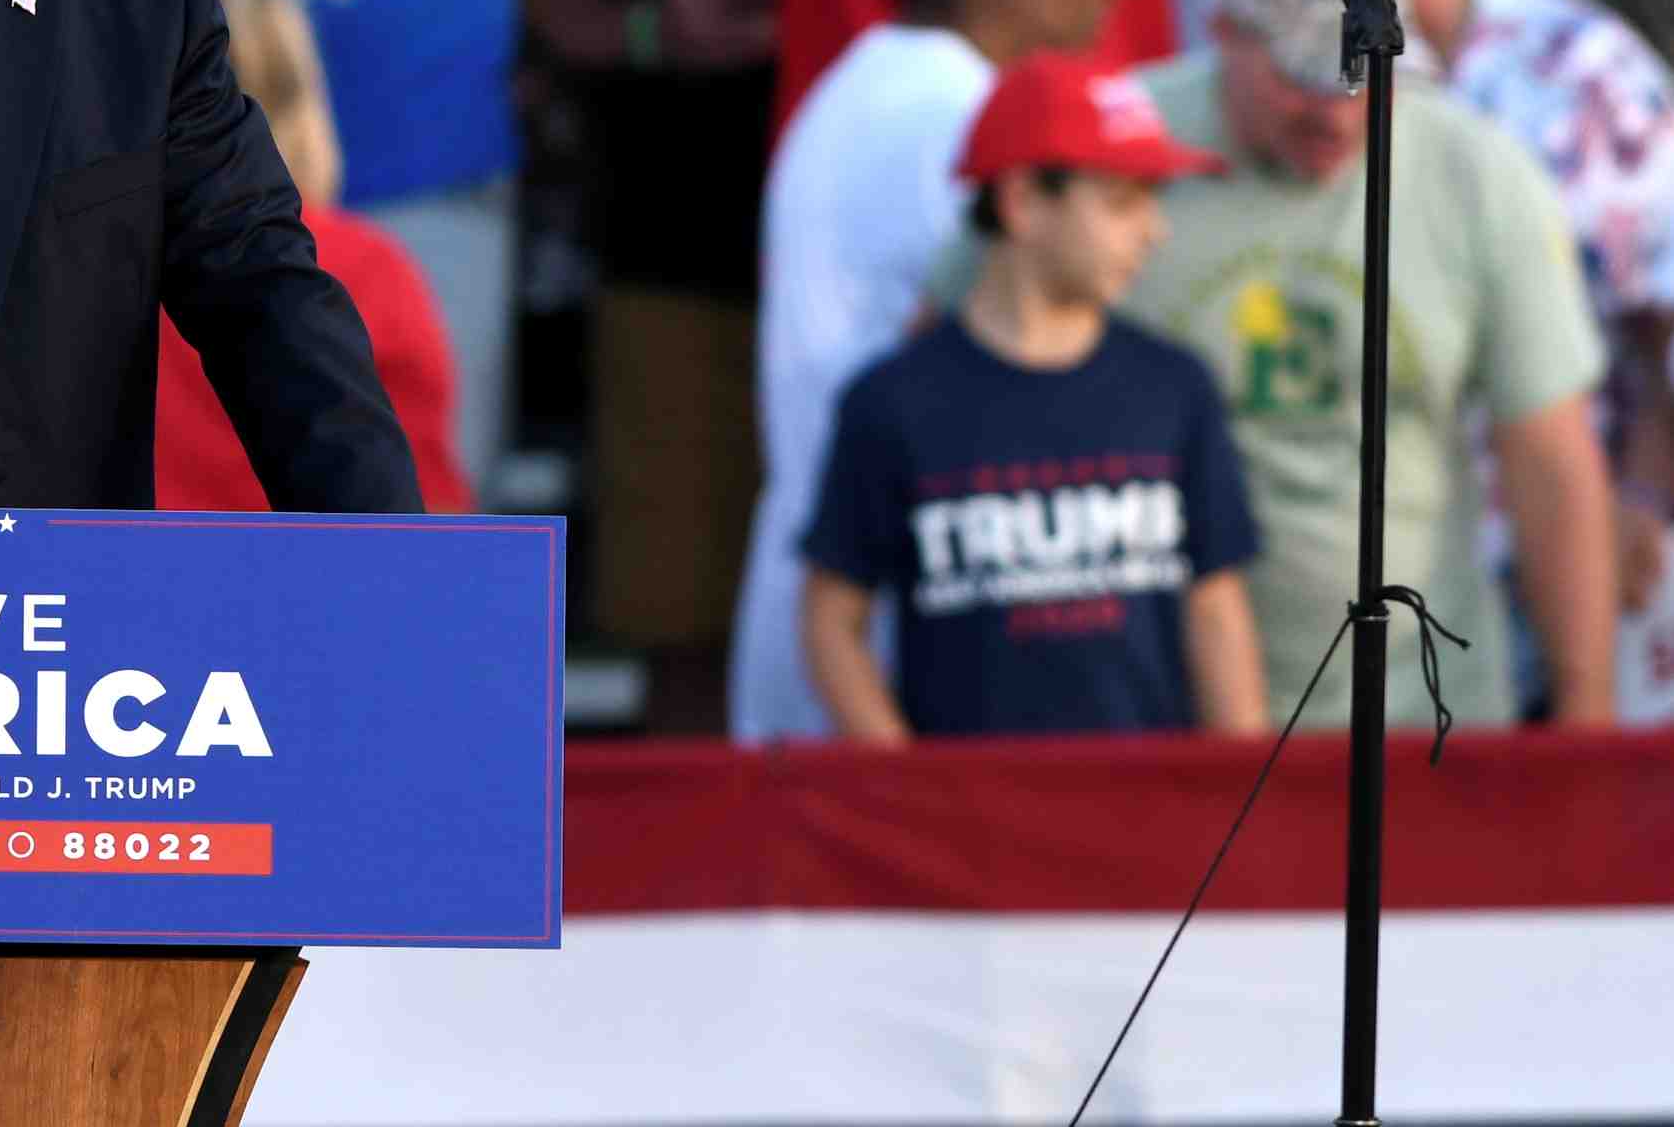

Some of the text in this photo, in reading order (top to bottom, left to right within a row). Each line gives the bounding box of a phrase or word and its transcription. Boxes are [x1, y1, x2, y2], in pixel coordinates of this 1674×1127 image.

[46, 776, 71, 799] J.
[84, 776, 196, 800] TRUMP
[63, 832, 210, 861] 88022
